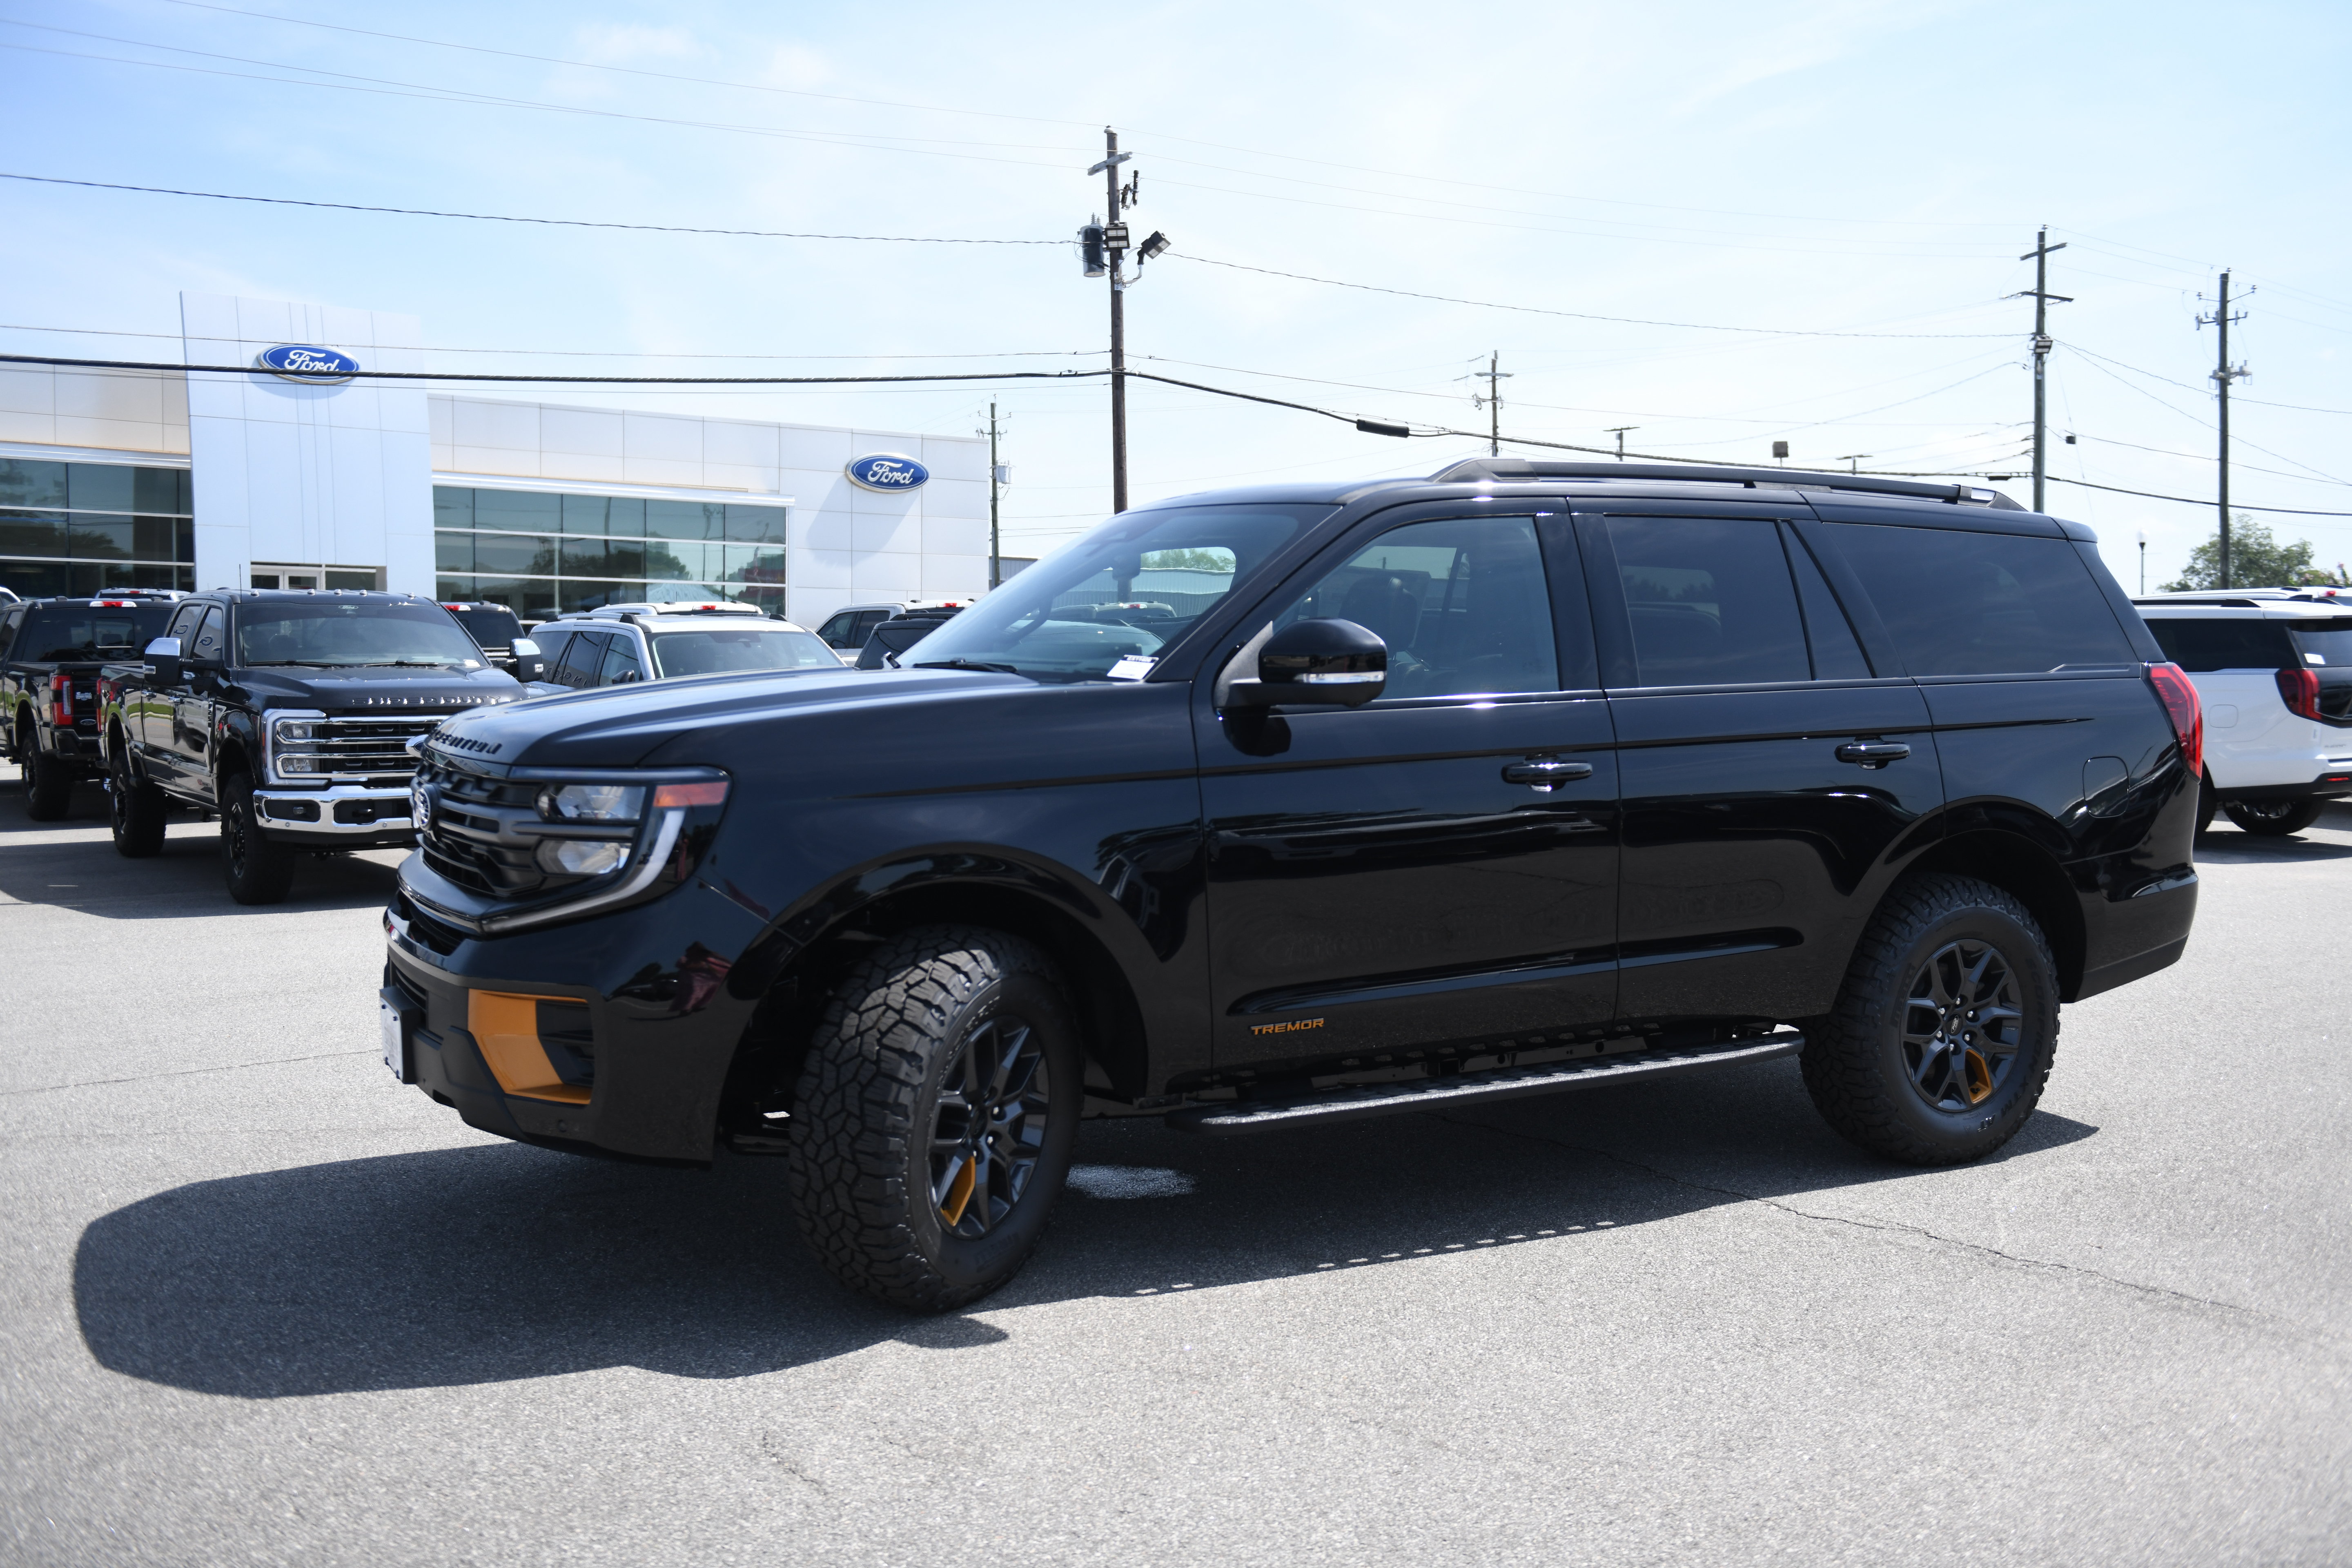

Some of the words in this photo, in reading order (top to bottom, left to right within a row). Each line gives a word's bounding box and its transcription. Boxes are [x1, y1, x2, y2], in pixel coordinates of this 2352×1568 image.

[284, 350, 339, 372] Ford
[868, 461, 914, 484] Ford
[352, 696, 437, 705] SUPER
[440, 696, 501, 705] DUTY
[1250, 1018, 1325, 1036] TREMOR
